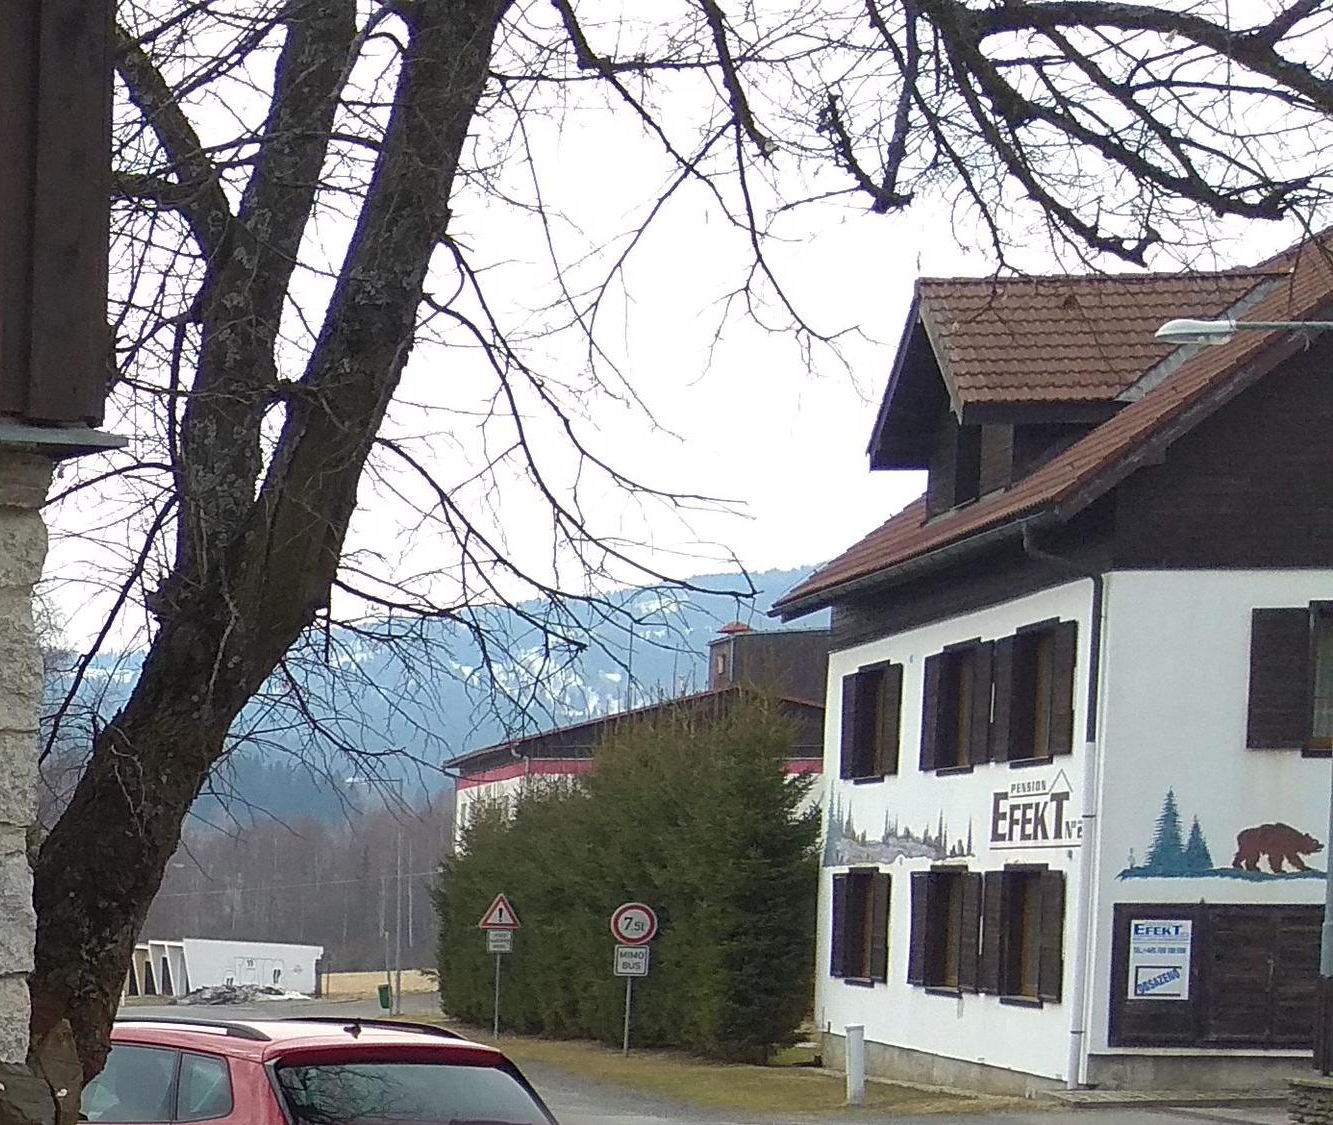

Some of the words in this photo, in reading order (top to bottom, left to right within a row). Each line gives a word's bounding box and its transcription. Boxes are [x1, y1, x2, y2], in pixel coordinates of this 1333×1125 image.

[1010, 780, 1046, 794] PENSION
[990, 791, 1070, 842] EFEKT
[621, 961, 641, 970] BUS
